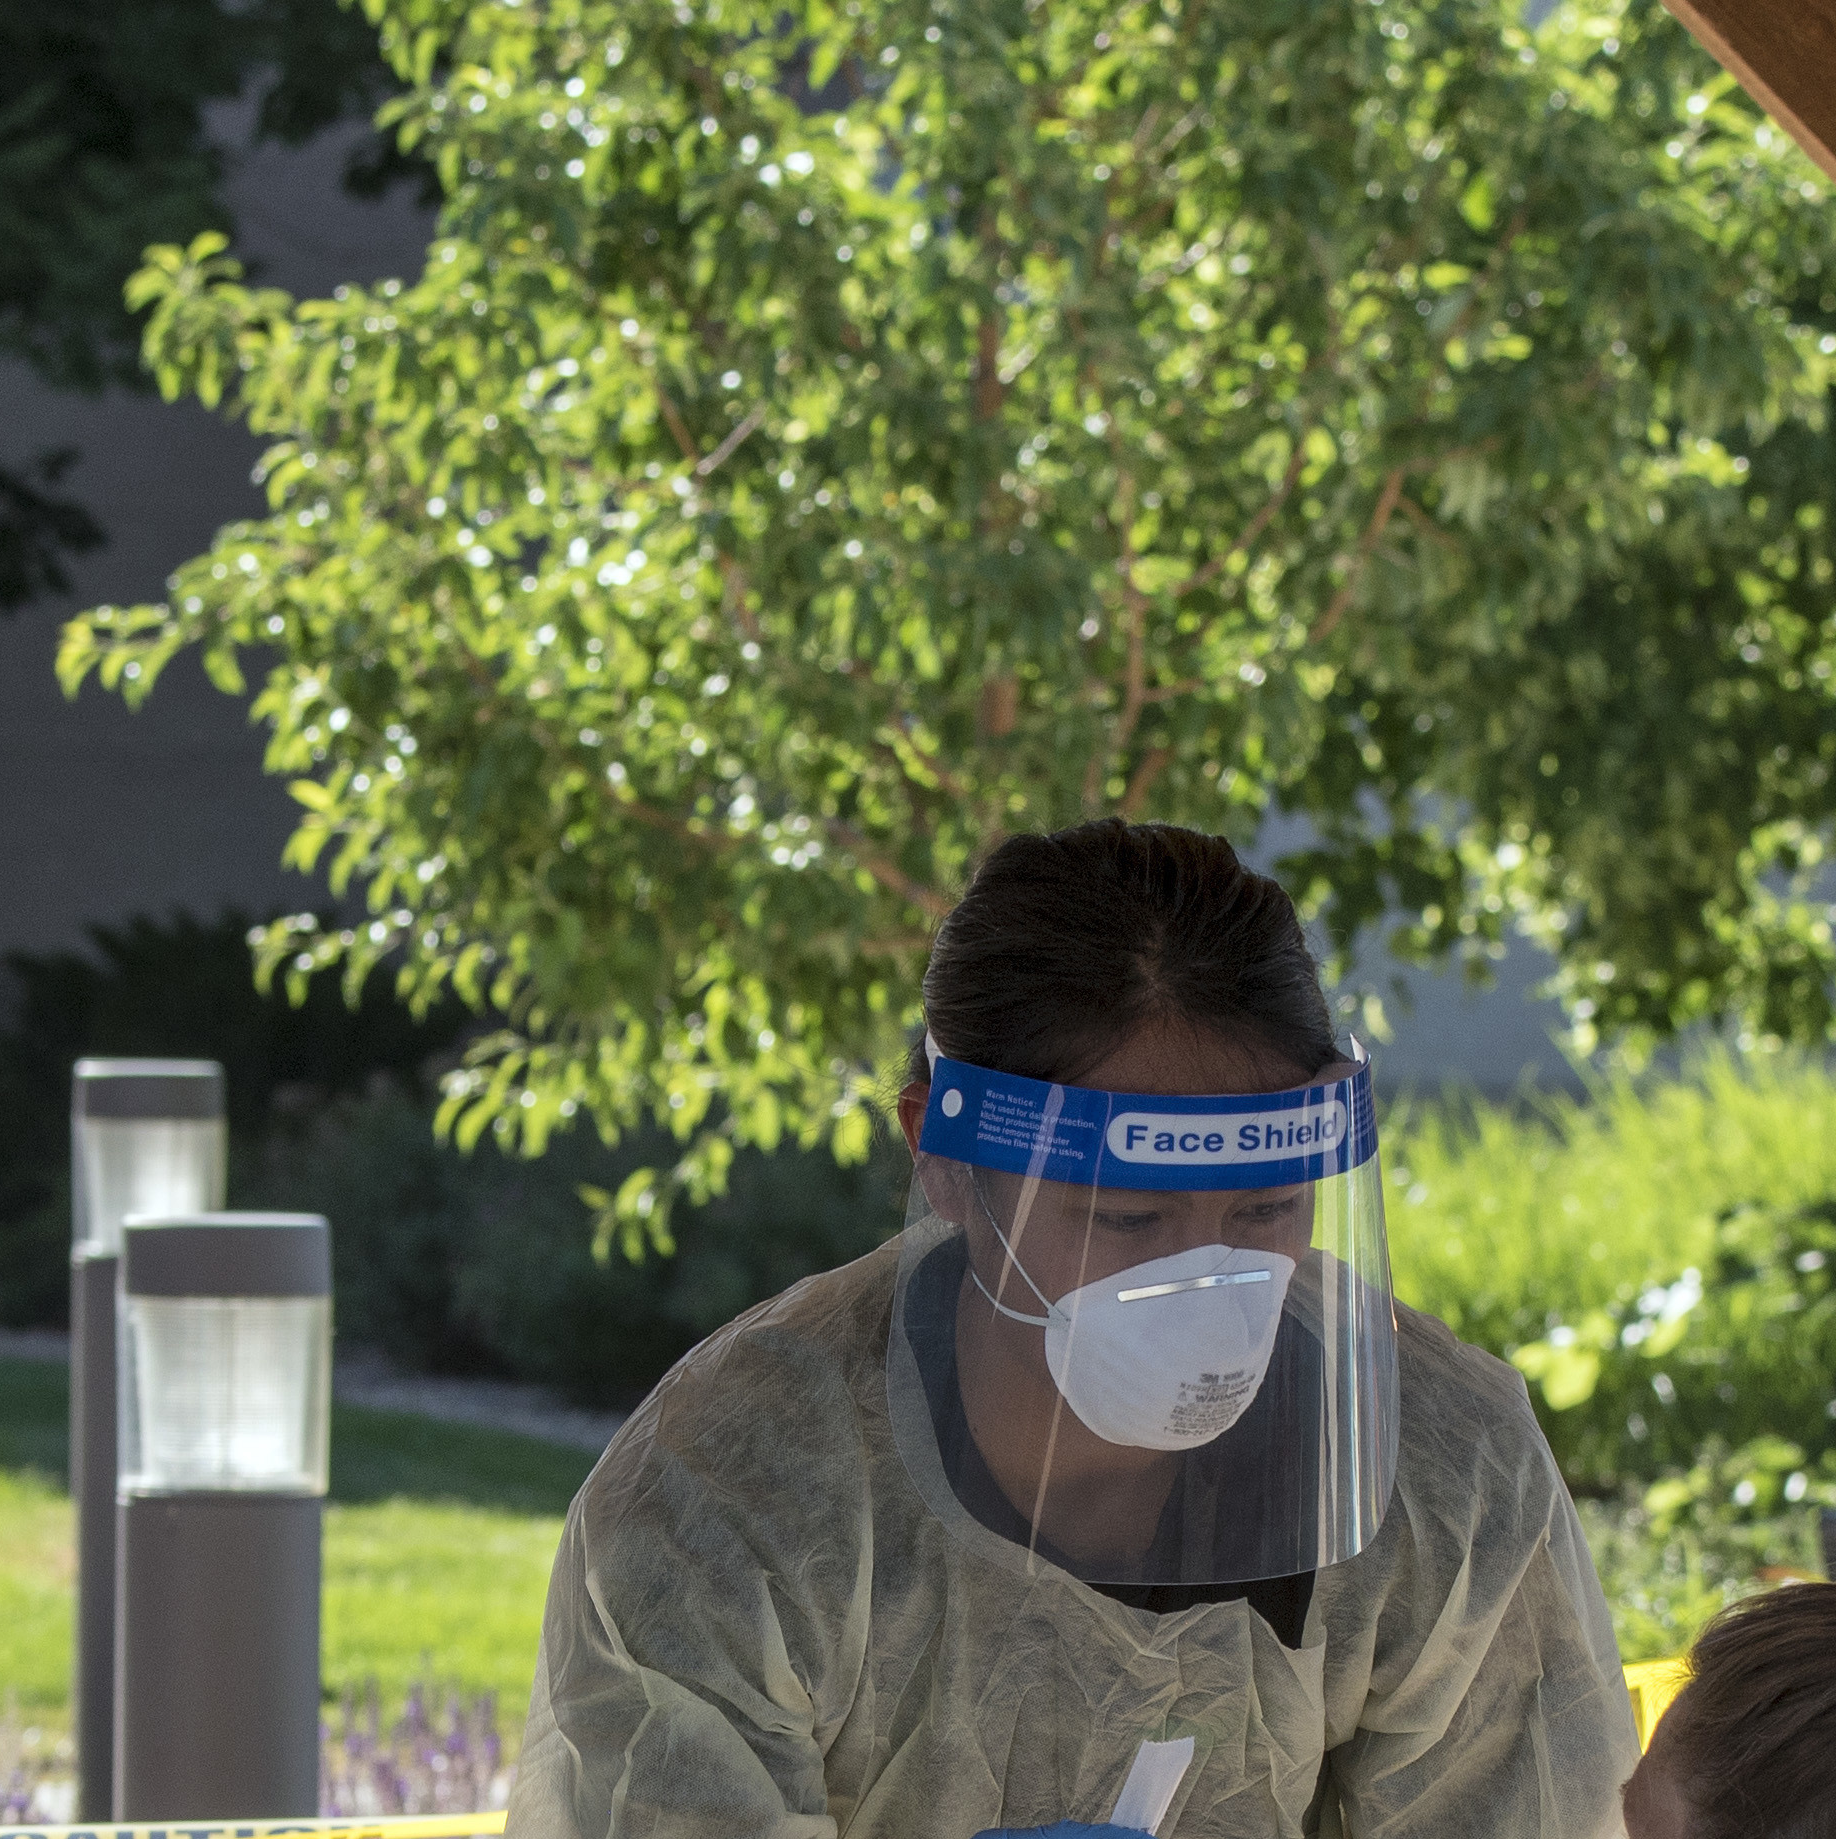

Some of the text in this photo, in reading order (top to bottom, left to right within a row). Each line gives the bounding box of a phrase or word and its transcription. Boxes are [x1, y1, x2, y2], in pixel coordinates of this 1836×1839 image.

[986, 1089, 1037, 1108] Warm Notice:
[980, 1110, 1004, 1123] kitchen
[982, 1100, 996, 1112] Only
[998, 1106, 1015, 1115] used
[1016, 1108, 1027, 1117] for
[1029, 1111, 1048, 1122] daily
[979, 1120, 1001, 1133] Please
[1002, 1126, 1031, 1139] remove
[1047, 1135, 1070, 1146] outer
[1125, 1123, 1225, 1153] Face
[1237, 1111, 1339, 1152] Shield
[977, 1132, 1086, 1160] protective film before using.
